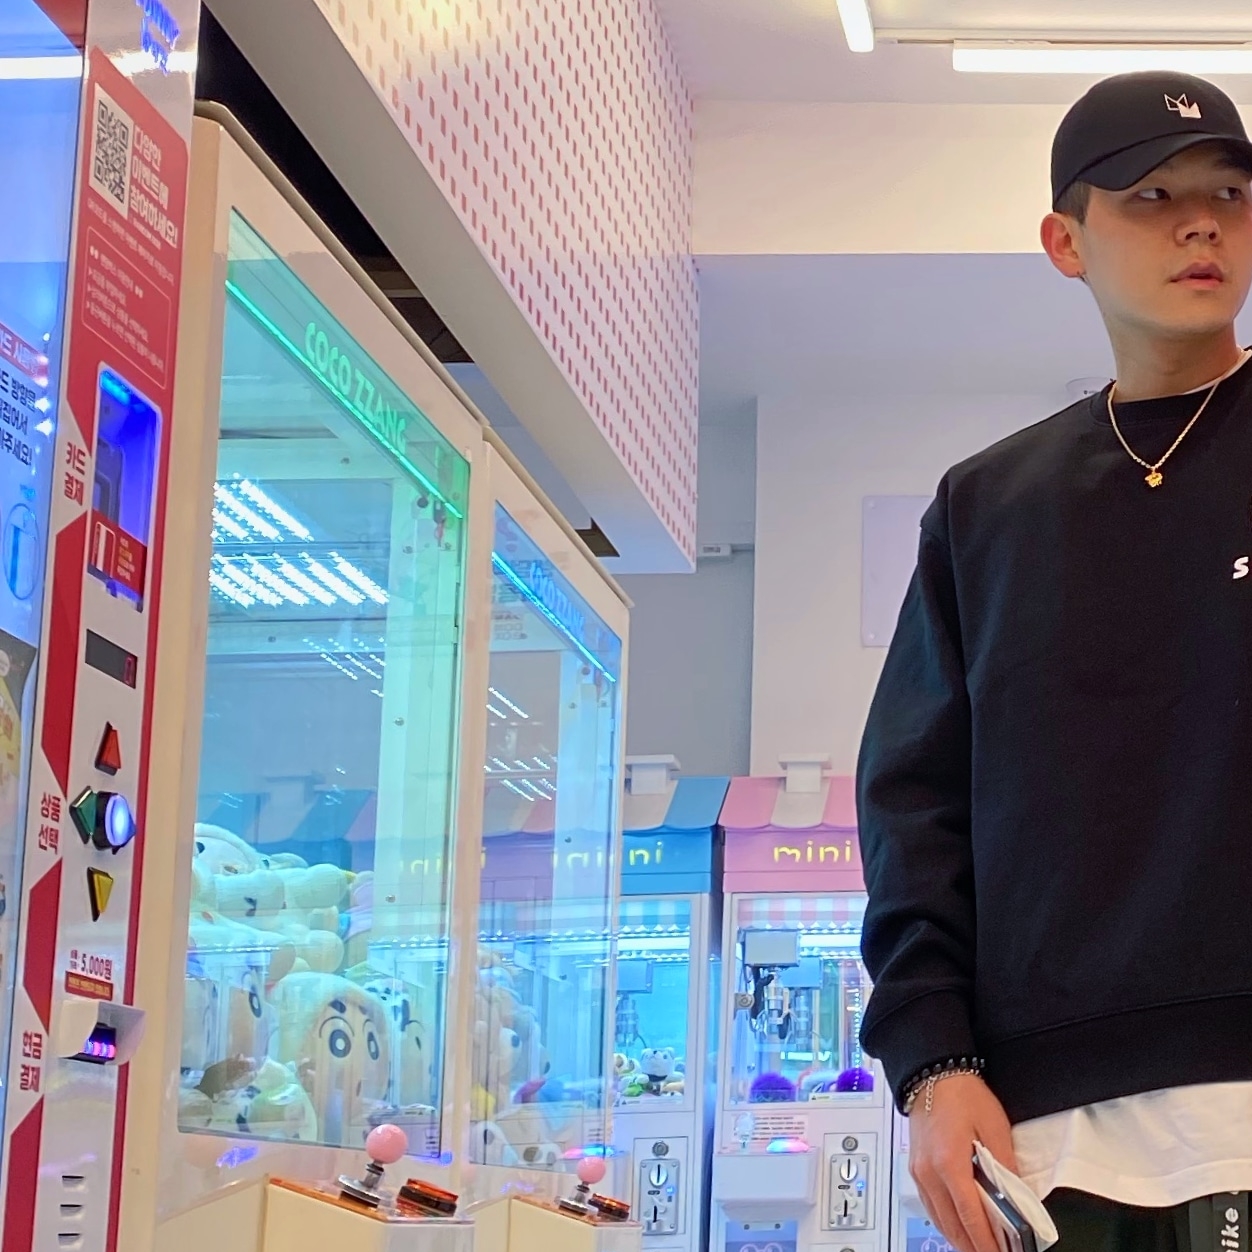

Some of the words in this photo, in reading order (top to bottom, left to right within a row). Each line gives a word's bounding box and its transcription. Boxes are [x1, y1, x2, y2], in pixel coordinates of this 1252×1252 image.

[134, 125, 161, 171] 다양한
[305, 322, 351, 395] COCO
[66, 442, 86, 475] 카드
[64, 472, 84, 506] 결제
[41, 792, 61, 823] 상품
[39, 824, 59, 855] 선택
[629, 841, 663, 865] ni
[773, 841, 852, 863] mini
[81, 953, 112, 980] 5,000원
[22, 1030, 42, 1060] 현금
